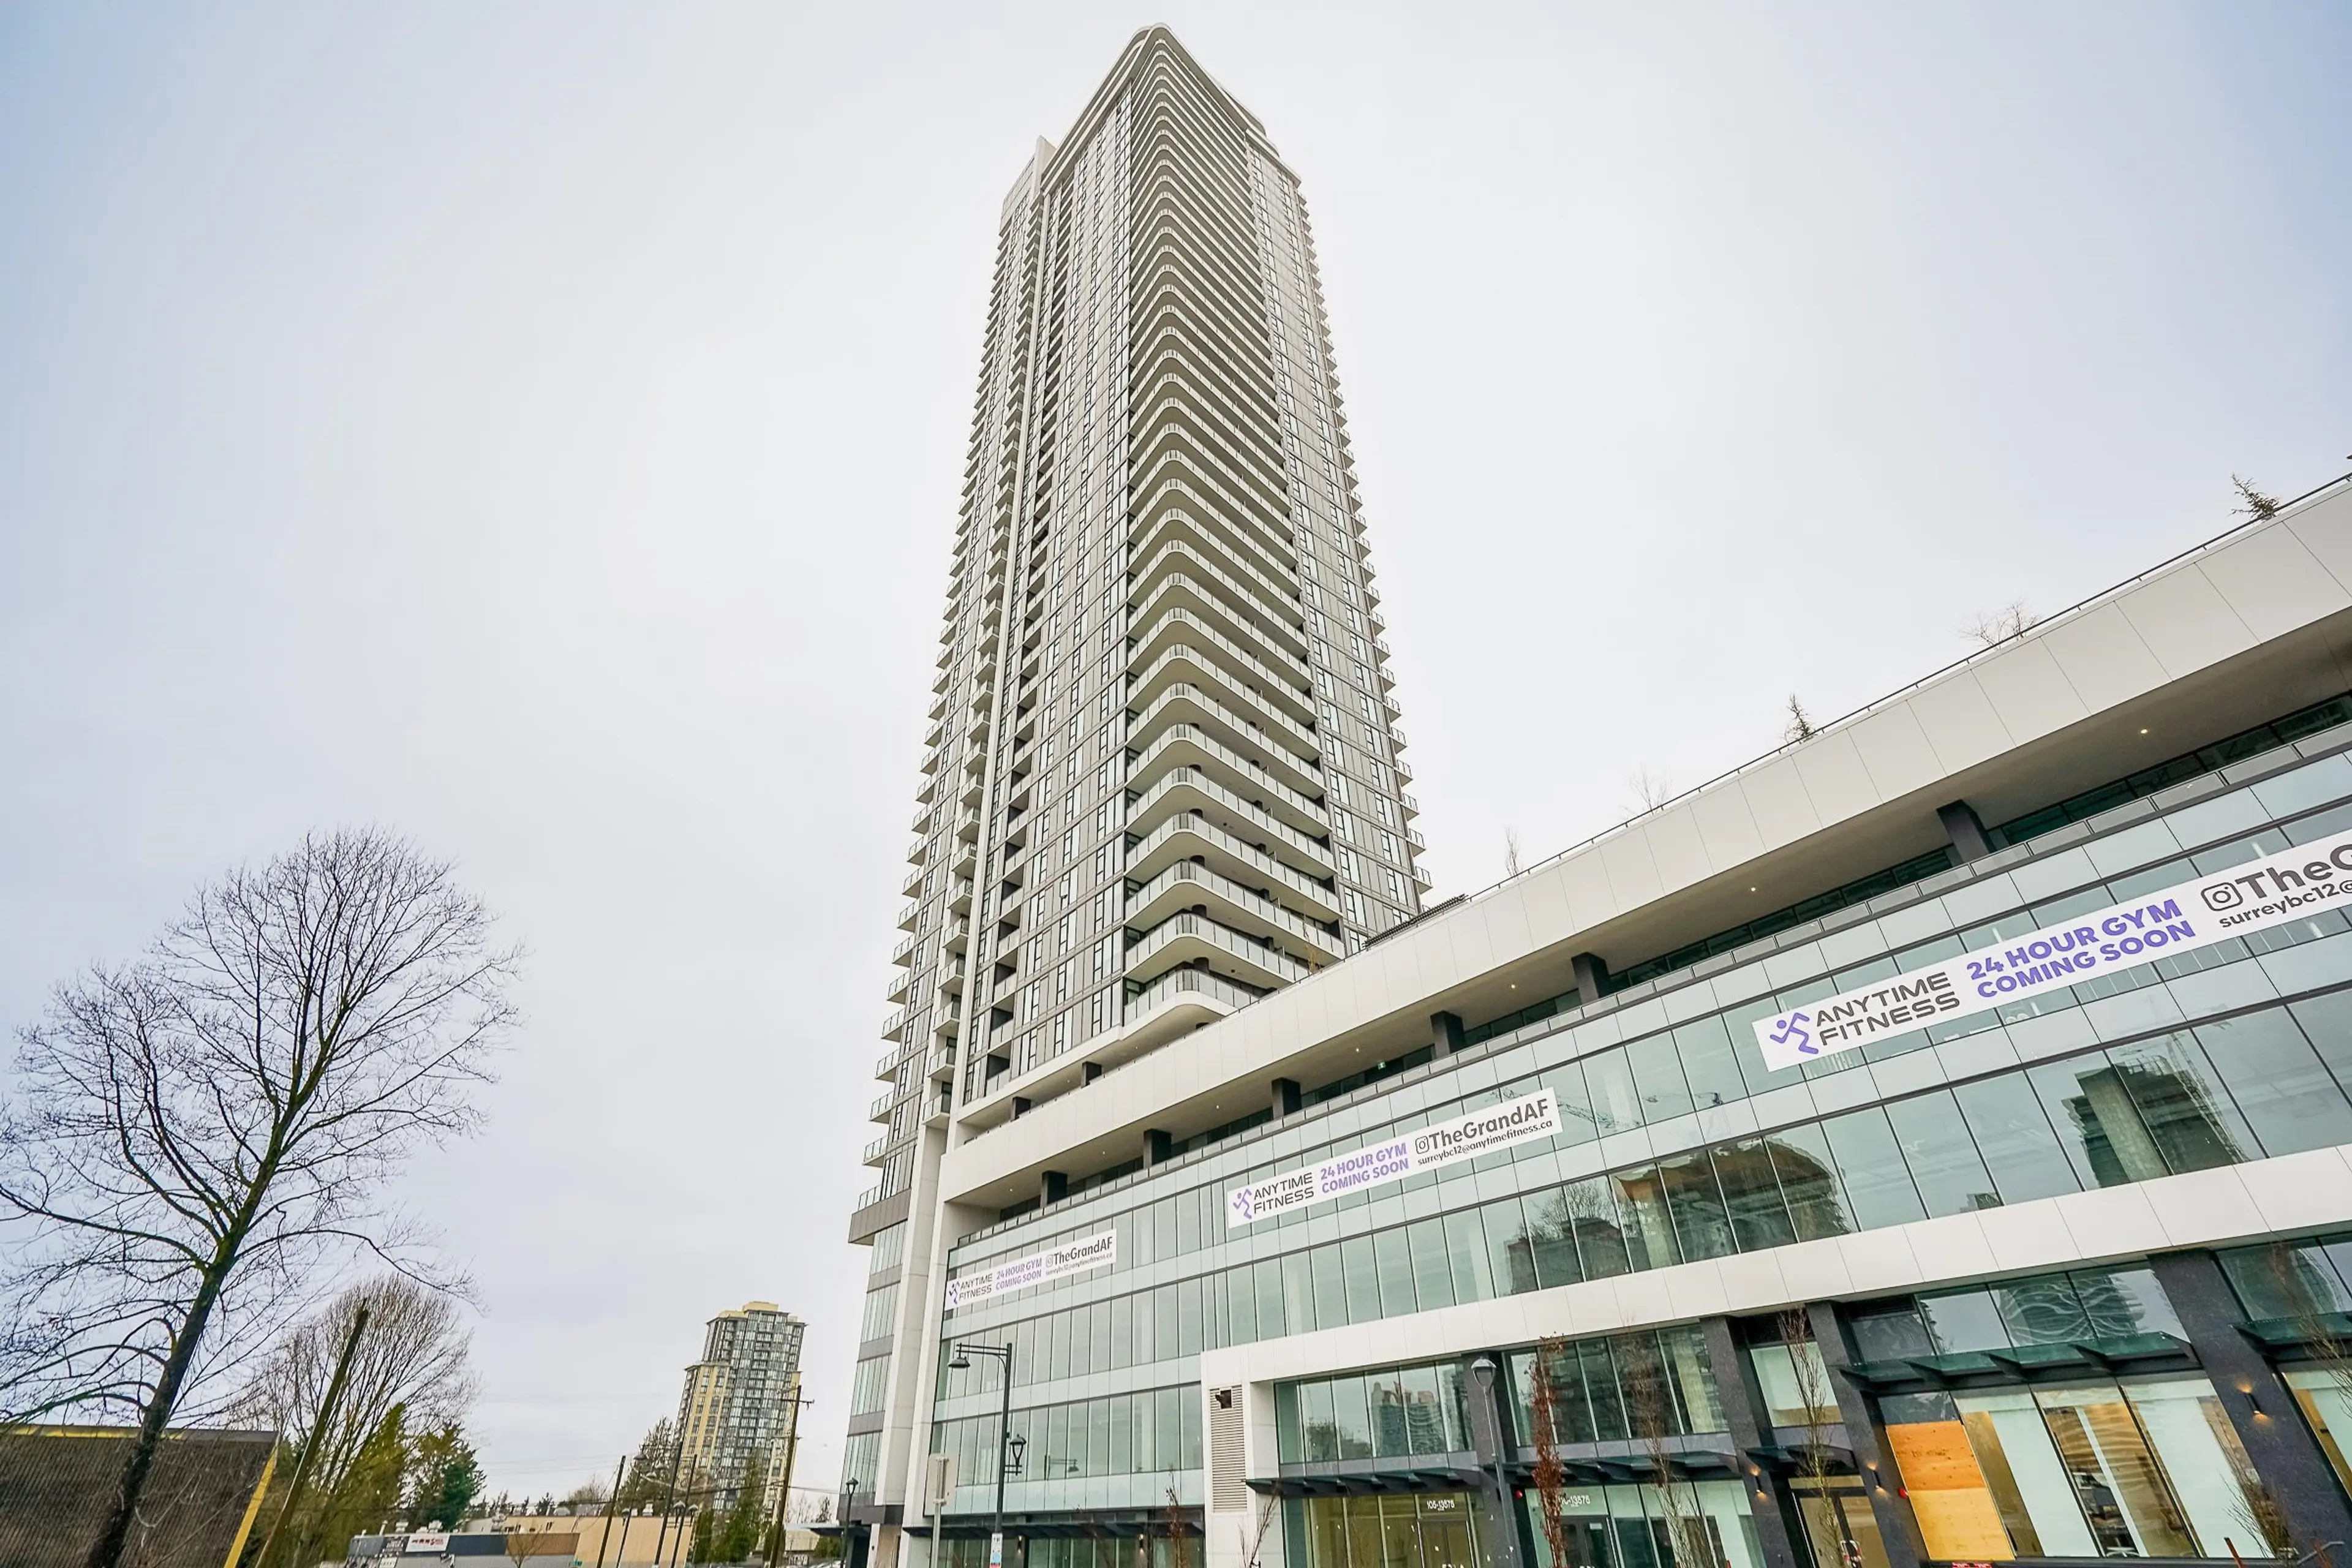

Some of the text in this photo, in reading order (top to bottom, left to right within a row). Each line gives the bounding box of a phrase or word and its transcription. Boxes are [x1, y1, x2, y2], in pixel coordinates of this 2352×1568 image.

[1967, 899, 2182, 980] 24 HOUR GYM
[1978, 920, 2196, 997] COMING SOON
[1817, 971, 1951, 1027] ANYTIME
[1820, 991, 1960, 1046] FITNESS
[1429, 1098, 1548, 1149] TheGrandAF
[1418, 1120, 1553, 1166] surreybc12@anytimefitness.ca
[1321, 1143, 1408, 1180] 24 HOUR GYM
[1322, 1158, 1409, 1193] COMING SOON
[1254, 1172, 1313, 1200] ANYTIME
[1254, 1187, 1314, 1214] FITNESS
[997, 1257, 1042, 1280] 24 HOUR GYM
[1054, 1237, 1112, 1265] TheGrandAF
[959, 1285, 992, 1301] FITNESS
[960, 1273, 993, 1290] ANYTIME
[996, 1269, 1042, 1290] COMING SOON
